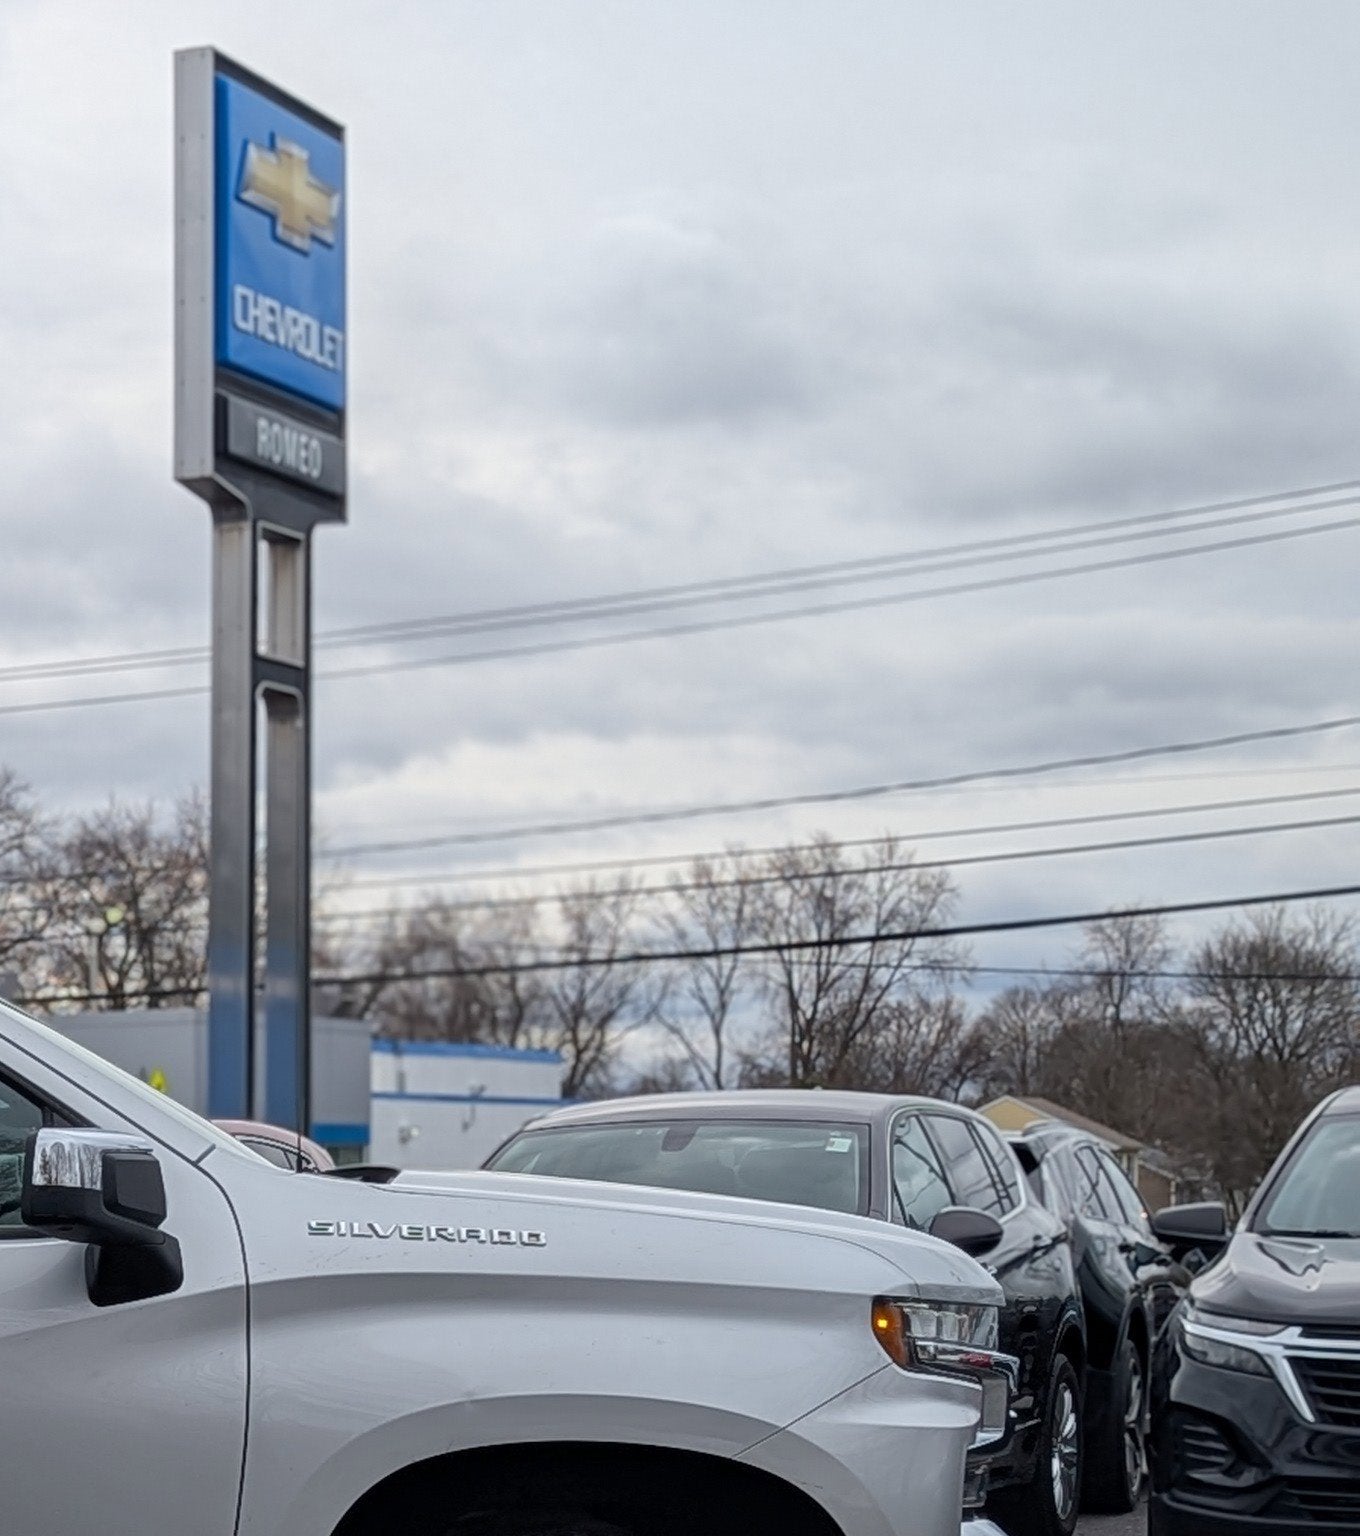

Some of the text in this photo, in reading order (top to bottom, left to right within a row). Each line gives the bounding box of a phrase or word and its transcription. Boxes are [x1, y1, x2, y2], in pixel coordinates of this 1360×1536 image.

[233, 284, 344, 370] CHEVROLET
[257, 418, 321, 478] ROMEO
[307, 1219, 547, 1246] SILVERADO
